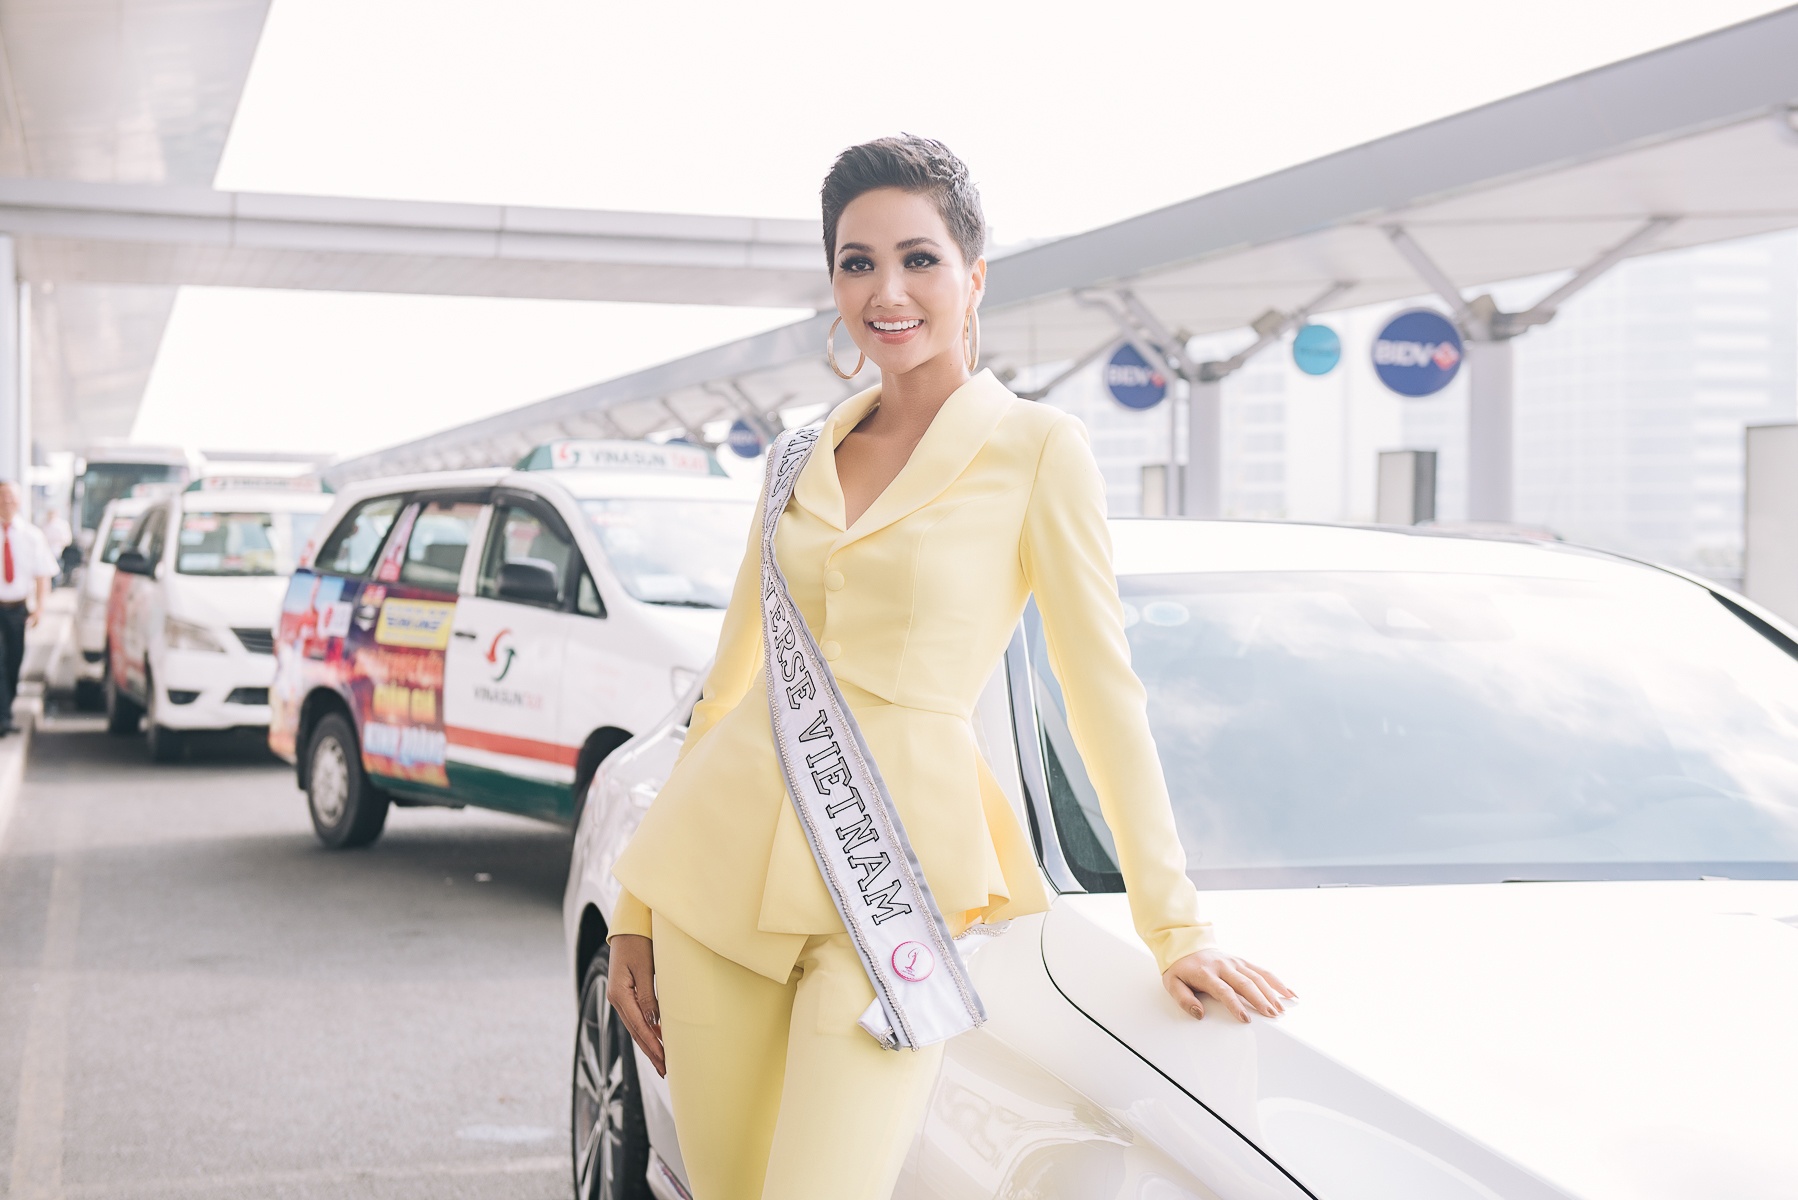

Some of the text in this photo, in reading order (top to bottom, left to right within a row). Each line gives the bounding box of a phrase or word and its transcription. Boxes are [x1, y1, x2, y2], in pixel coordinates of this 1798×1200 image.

[1374, 338, 1436, 368] BIDV
[591, 450, 666, 467] VINASUN
[771, 427, 822, 498] MISS
[798, 709, 912, 926] VIETNAM
